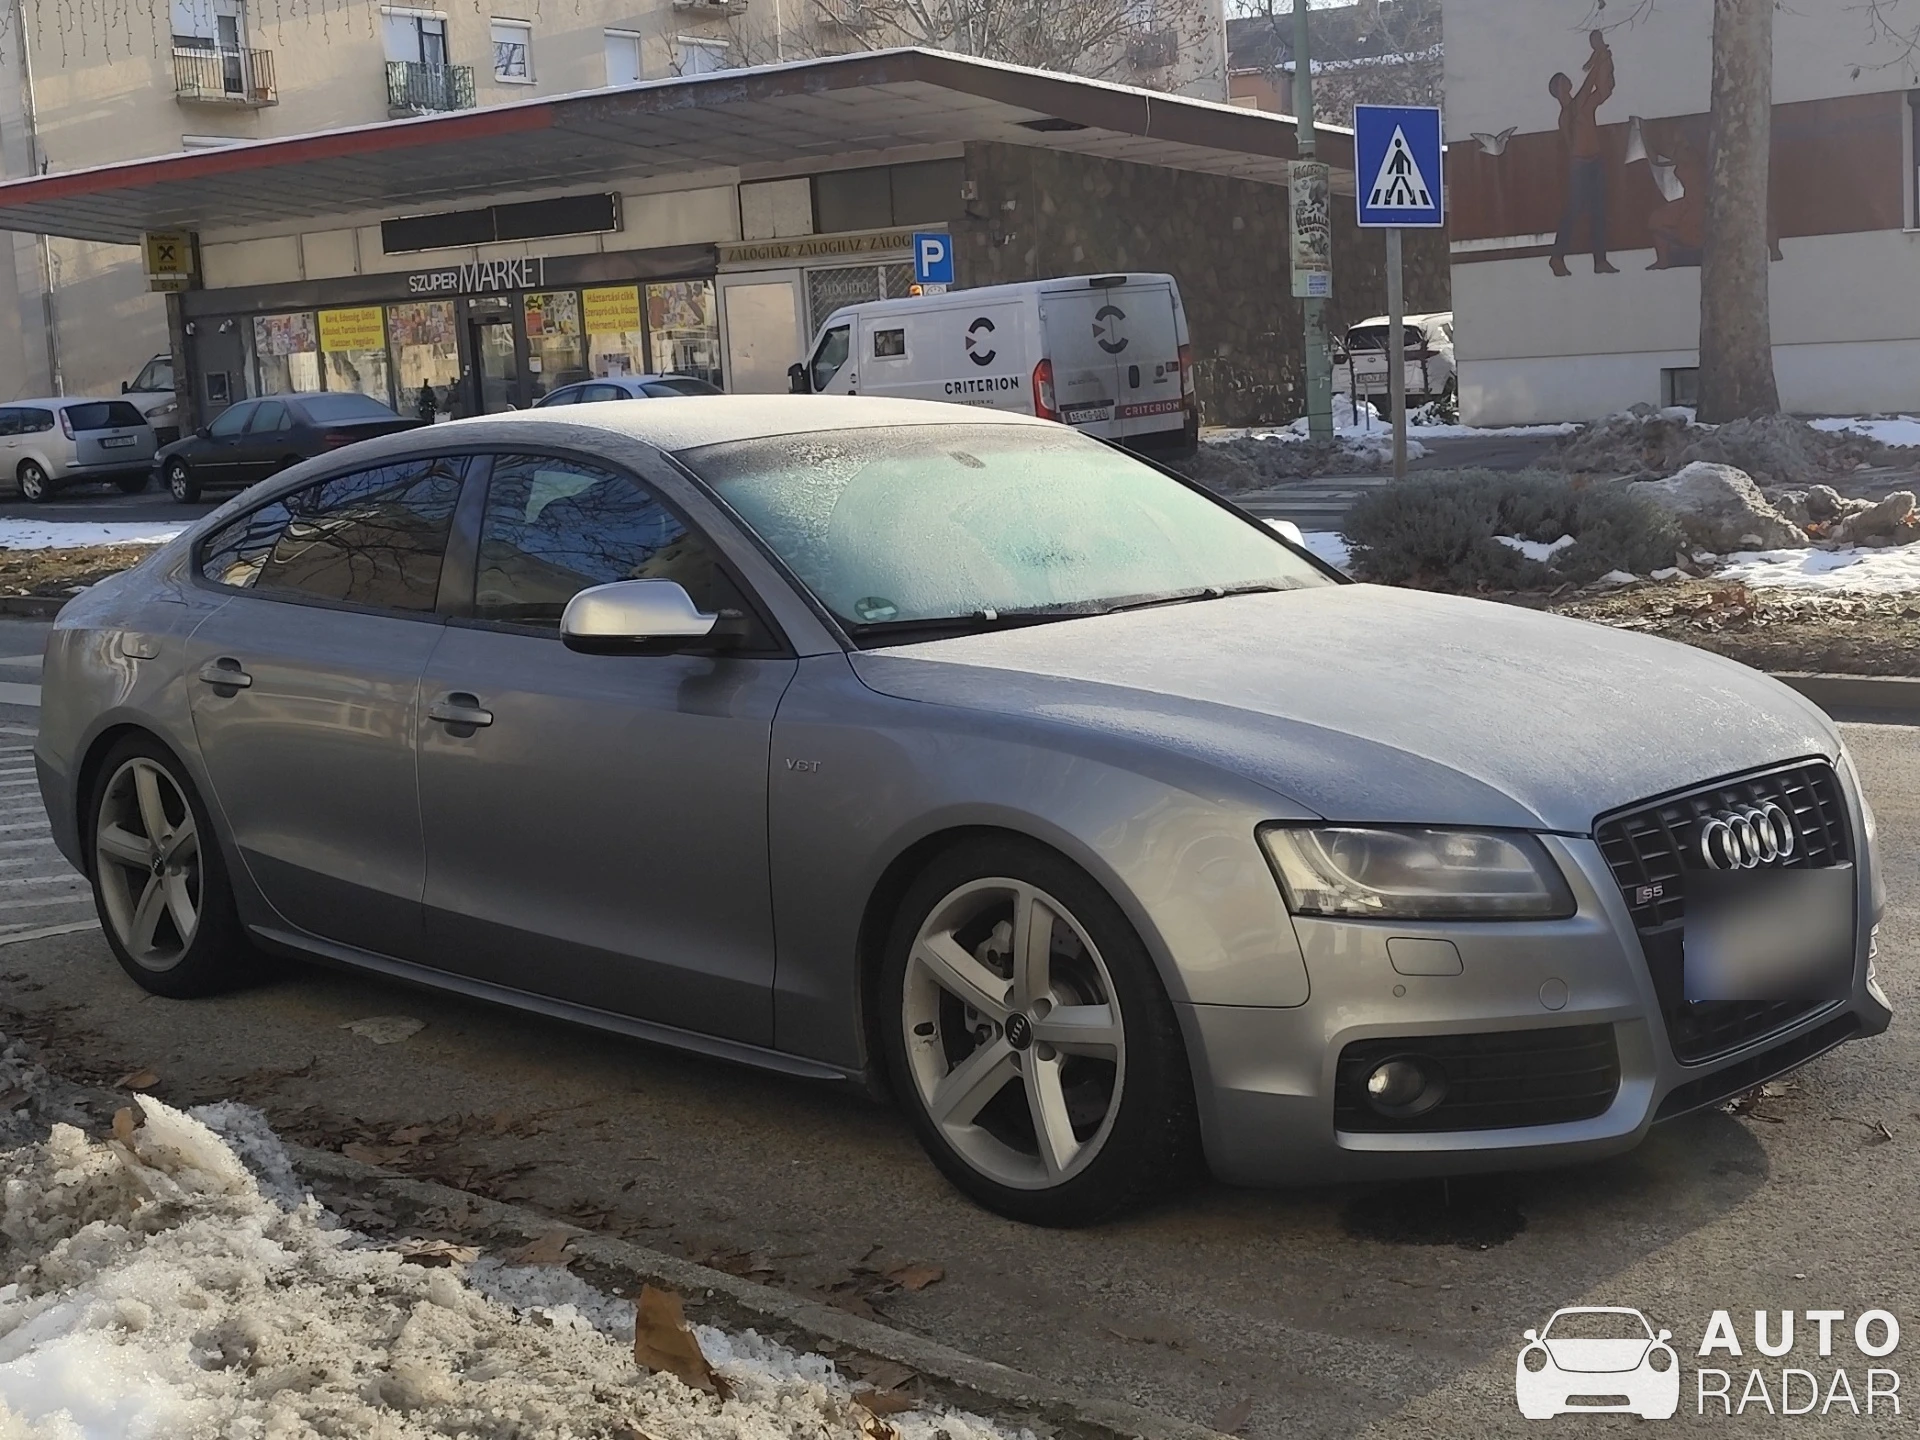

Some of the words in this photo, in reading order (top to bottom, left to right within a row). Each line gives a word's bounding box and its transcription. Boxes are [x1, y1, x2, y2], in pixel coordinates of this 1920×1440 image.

[798, 237, 863, 256] ZÁLOGHÁZ
[921, 239, 944, 277] P
[408, 272, 458, 293] SZUPER
[458, 253, 549, 294] MARKET
[944, 376, 1019, 395] CRITERION
[1125, 401, 1179, 416] CRITERION
[785, 758, 821, 773] V6T
[1642, 884, 1664, 900] S5
